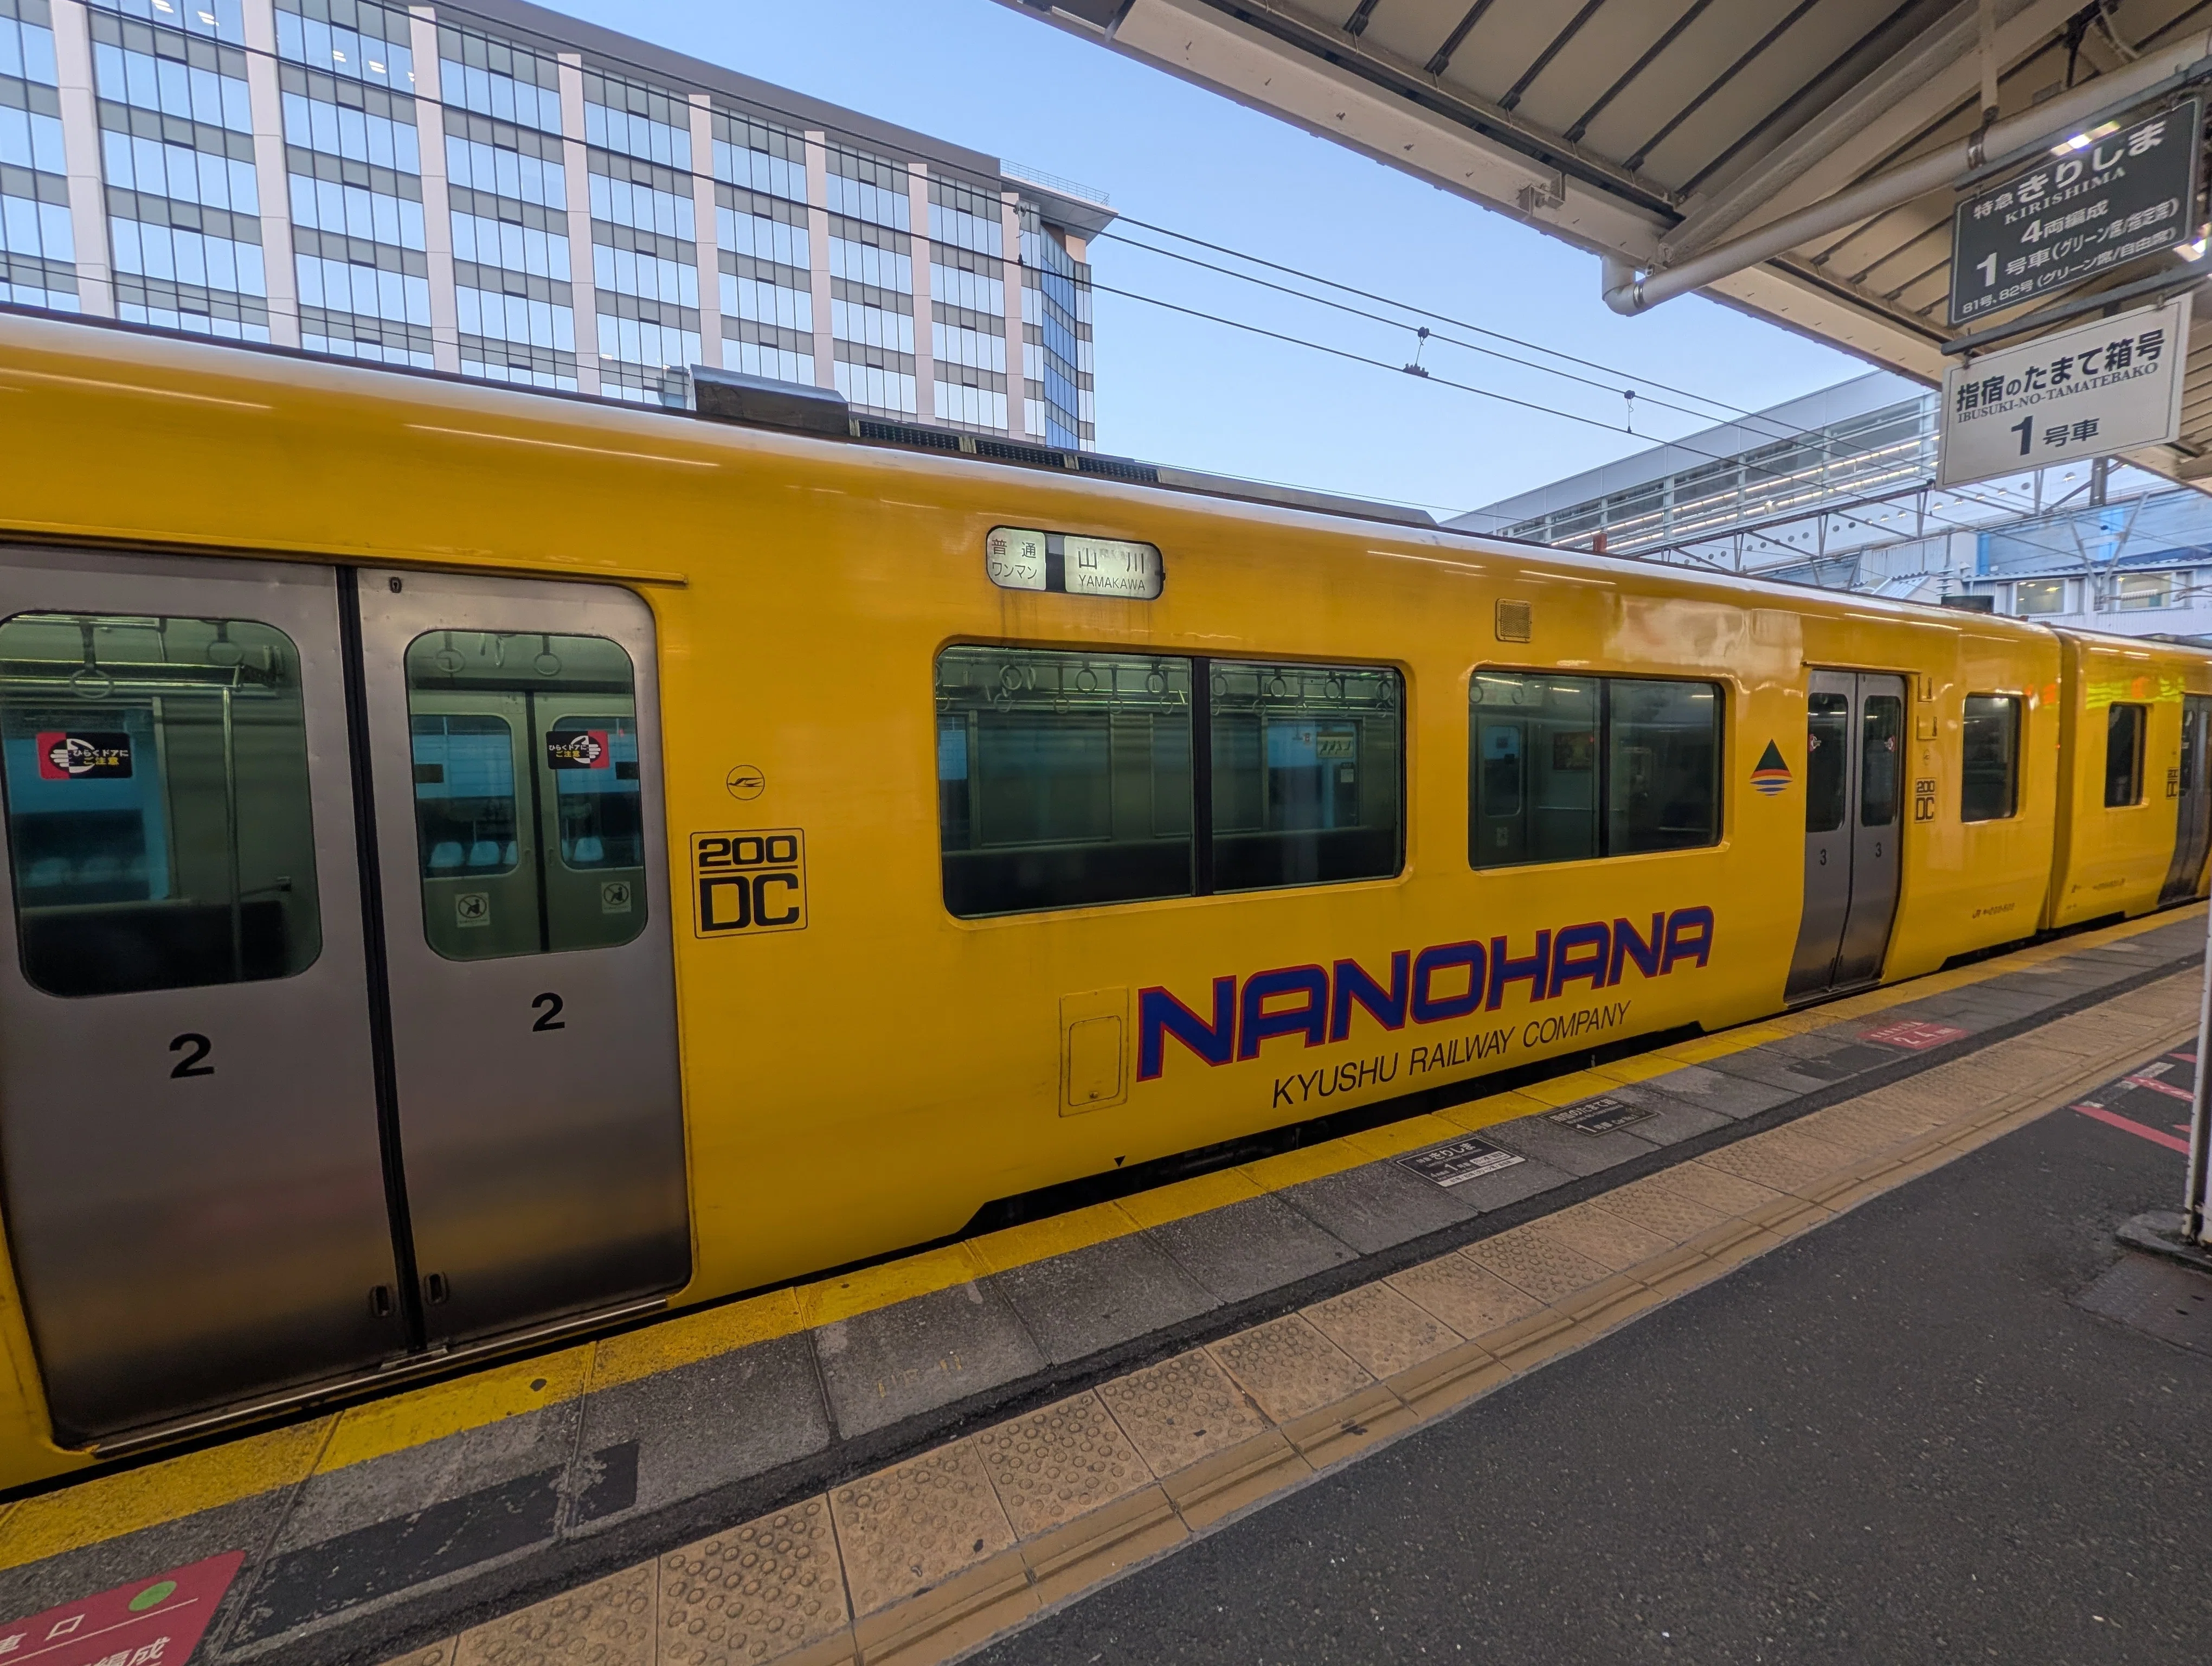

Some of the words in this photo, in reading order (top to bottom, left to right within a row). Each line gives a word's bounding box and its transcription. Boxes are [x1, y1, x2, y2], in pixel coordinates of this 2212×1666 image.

[2005, 166, 2126, 225] KIRISHIMA
[1956, 328, 2165, 412] 指宿のたまて箱号
[1958, 362, 2158, 424] IBUSUKI-NO-TAMATEBAKO
[2011, 415, 2100, 456] 1号車
[992, 562, 1037, 580] ワンマン
[1078, 574, 1146, 591] YAMAKAWA
[1915, 796, 1935, 821] DC
[698, 835, 798, 868] 200
[1819, 848, 1827, 866] 3
[1875, 842, 1882, 858] 3
[699, 873, 800, 932] DC
[531, 992, 565, 1033] 2
[1136, 905, 1715, 1083] NANOHANA
[169, 1033, 215, 1079] 2
[1272, 1052, 1399, 1108] KYUSHU
[1410, 1027, 1516, 1076] RAILWAY
[1523, 1001, 1632, 1047] COMPANY
